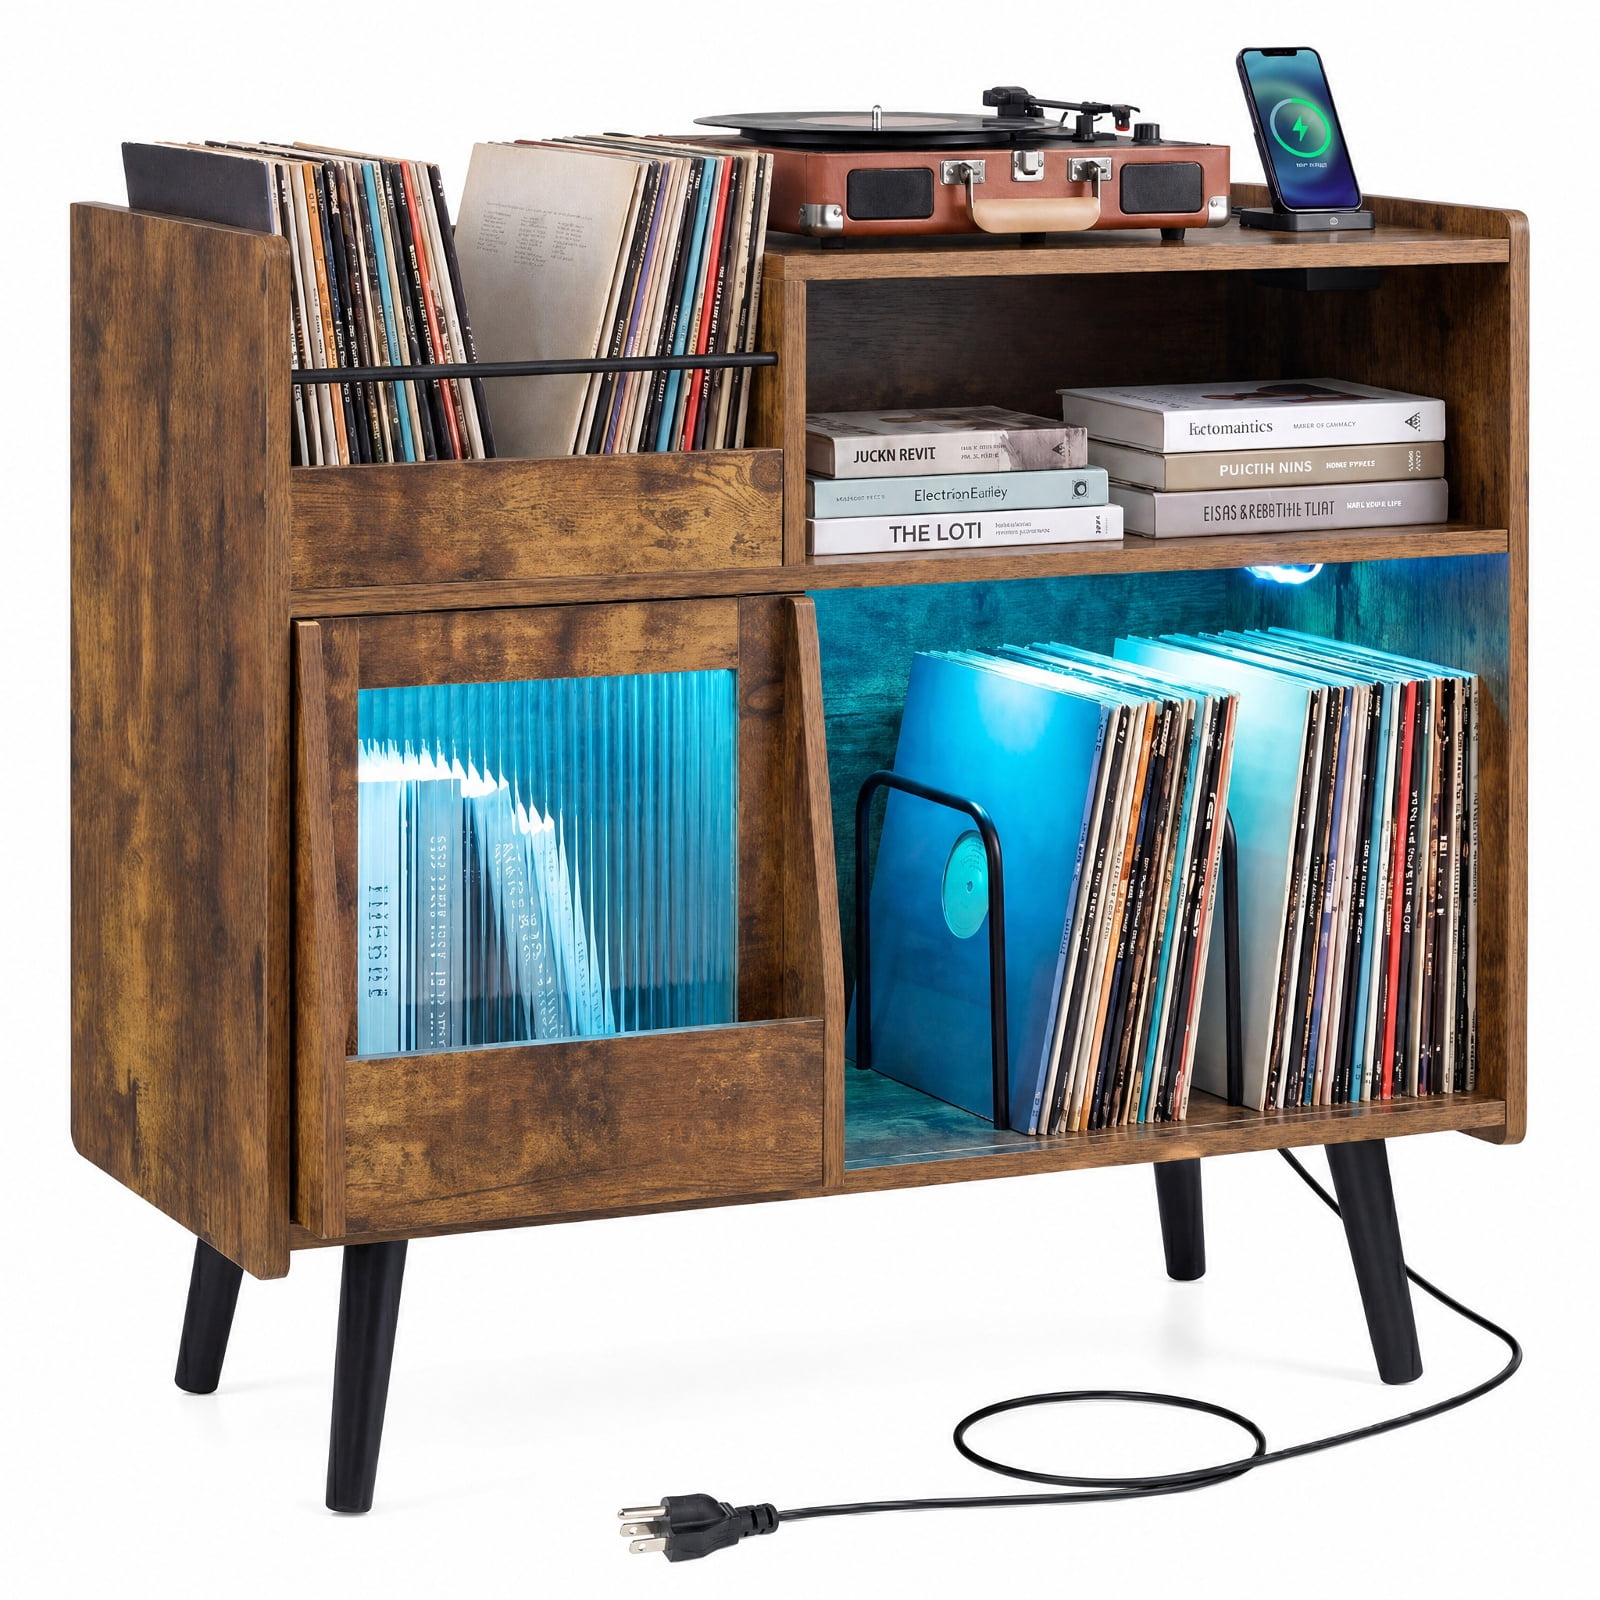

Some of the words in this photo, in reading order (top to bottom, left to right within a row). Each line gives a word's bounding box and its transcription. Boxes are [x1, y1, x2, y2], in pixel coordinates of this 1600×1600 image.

[853, 449, 896, 464] JUCKN
[899, 446, 936, 461] REVIT
[1279, 460, 1313, 473] NINS
[1203, 504, 1237, 522] EISAS
[889, 523, 930, 543] THE
[937, 521, 982, 541] LOTI
